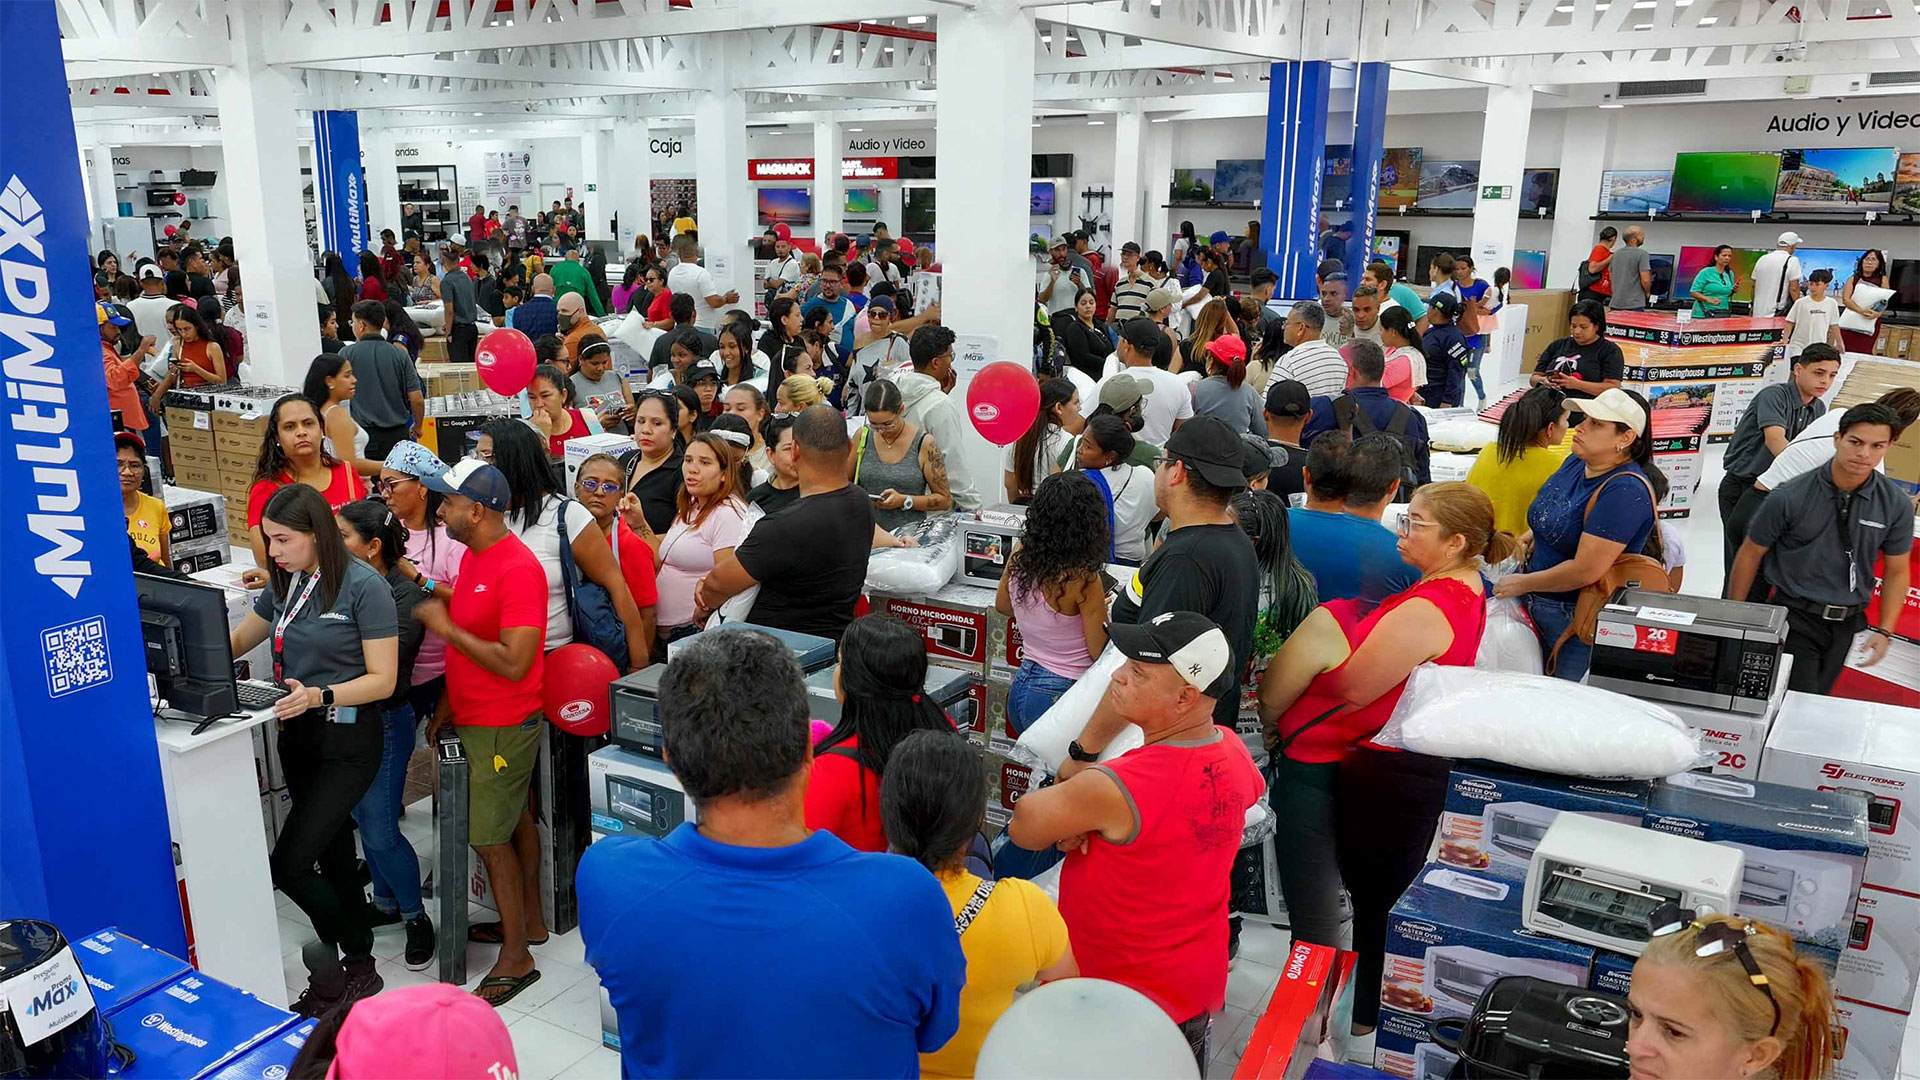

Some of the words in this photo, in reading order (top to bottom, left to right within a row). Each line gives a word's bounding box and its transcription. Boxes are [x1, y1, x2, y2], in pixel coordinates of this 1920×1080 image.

[1766, 112, 1830, 132] Audio
[1836, 116, 1850, 136] y
[1858, 110, 1920, 130] Video
[650, 138, 682, 157] Caja
[849, 138, 880, 150] Audio
[883, 141, 890, 153] y
[893, 138, 926, 150] Video
[112, 156, 130, 165] nas
[756, 164, 811, 175] MAGNAVOX
[1309, 165, 1320, 255] ultiMax
[348, 177, 362, 256] MultiMax
[1692, 334, 1736, 345] Westinghouse
[964, 353, 982, 361] Max
[1658, 368, 1705, 380] Westinghouse
[0, 209, 92, 576] MultiMax
[451, 420, 468, 428] Google
[1690, 437, 1699, 445] 43
[566, 446, 589, 454] DAEWOO
[890, 604, 919, 615] HORNO
[920, 610, 975, 625] MICROONDAS
[1648, 628, 1668, 640] 20
[592, 760, 608, 769] CORY
[1006, 768, 1030, 779] HORN
[1820, 763, 1845, 779] SJ
[1844, 772, 1906, 787] ELECTRONICS
[1454, 784, 1484, 794] TOASTER
[1461, 779, 1496, 790] Brentwood
[1462, 792, 1493, 802] GRILLE-PAIN
[1570, 785, 1639, 798] Brentwood
[1651, 822, 1682, 834] TOASTER
[1659, 816, 1698, 829] Brentwood
[1777, 822, 1854, 835] Brentwood
[1394, 925, 1424, 936] TOASTER
[1424, 932, 1442, 941] OVEN
[1402, 921, 1436, 933] Brentwood
[1402, 934, 1435, 945] GRILLE-PAIN
[33, 962, 60, 980] Pregunta
[1608, 971, 1632, 982] Brentw
[51, 974, 72, 991] Promo
[33, 982, 75, 1016] Max
[49, 1010, 78, 1029] MultiMax
[1391, 1016, 1425, 1029] Brentwood
[1382, 1027, 1402, 1037] HORNO
[1384, 1019, 1413, 1030] TOASTER
[1413, 1027, 1430, 1037] OVEN
[157, 1021, 208, 1048] Westinghouse
